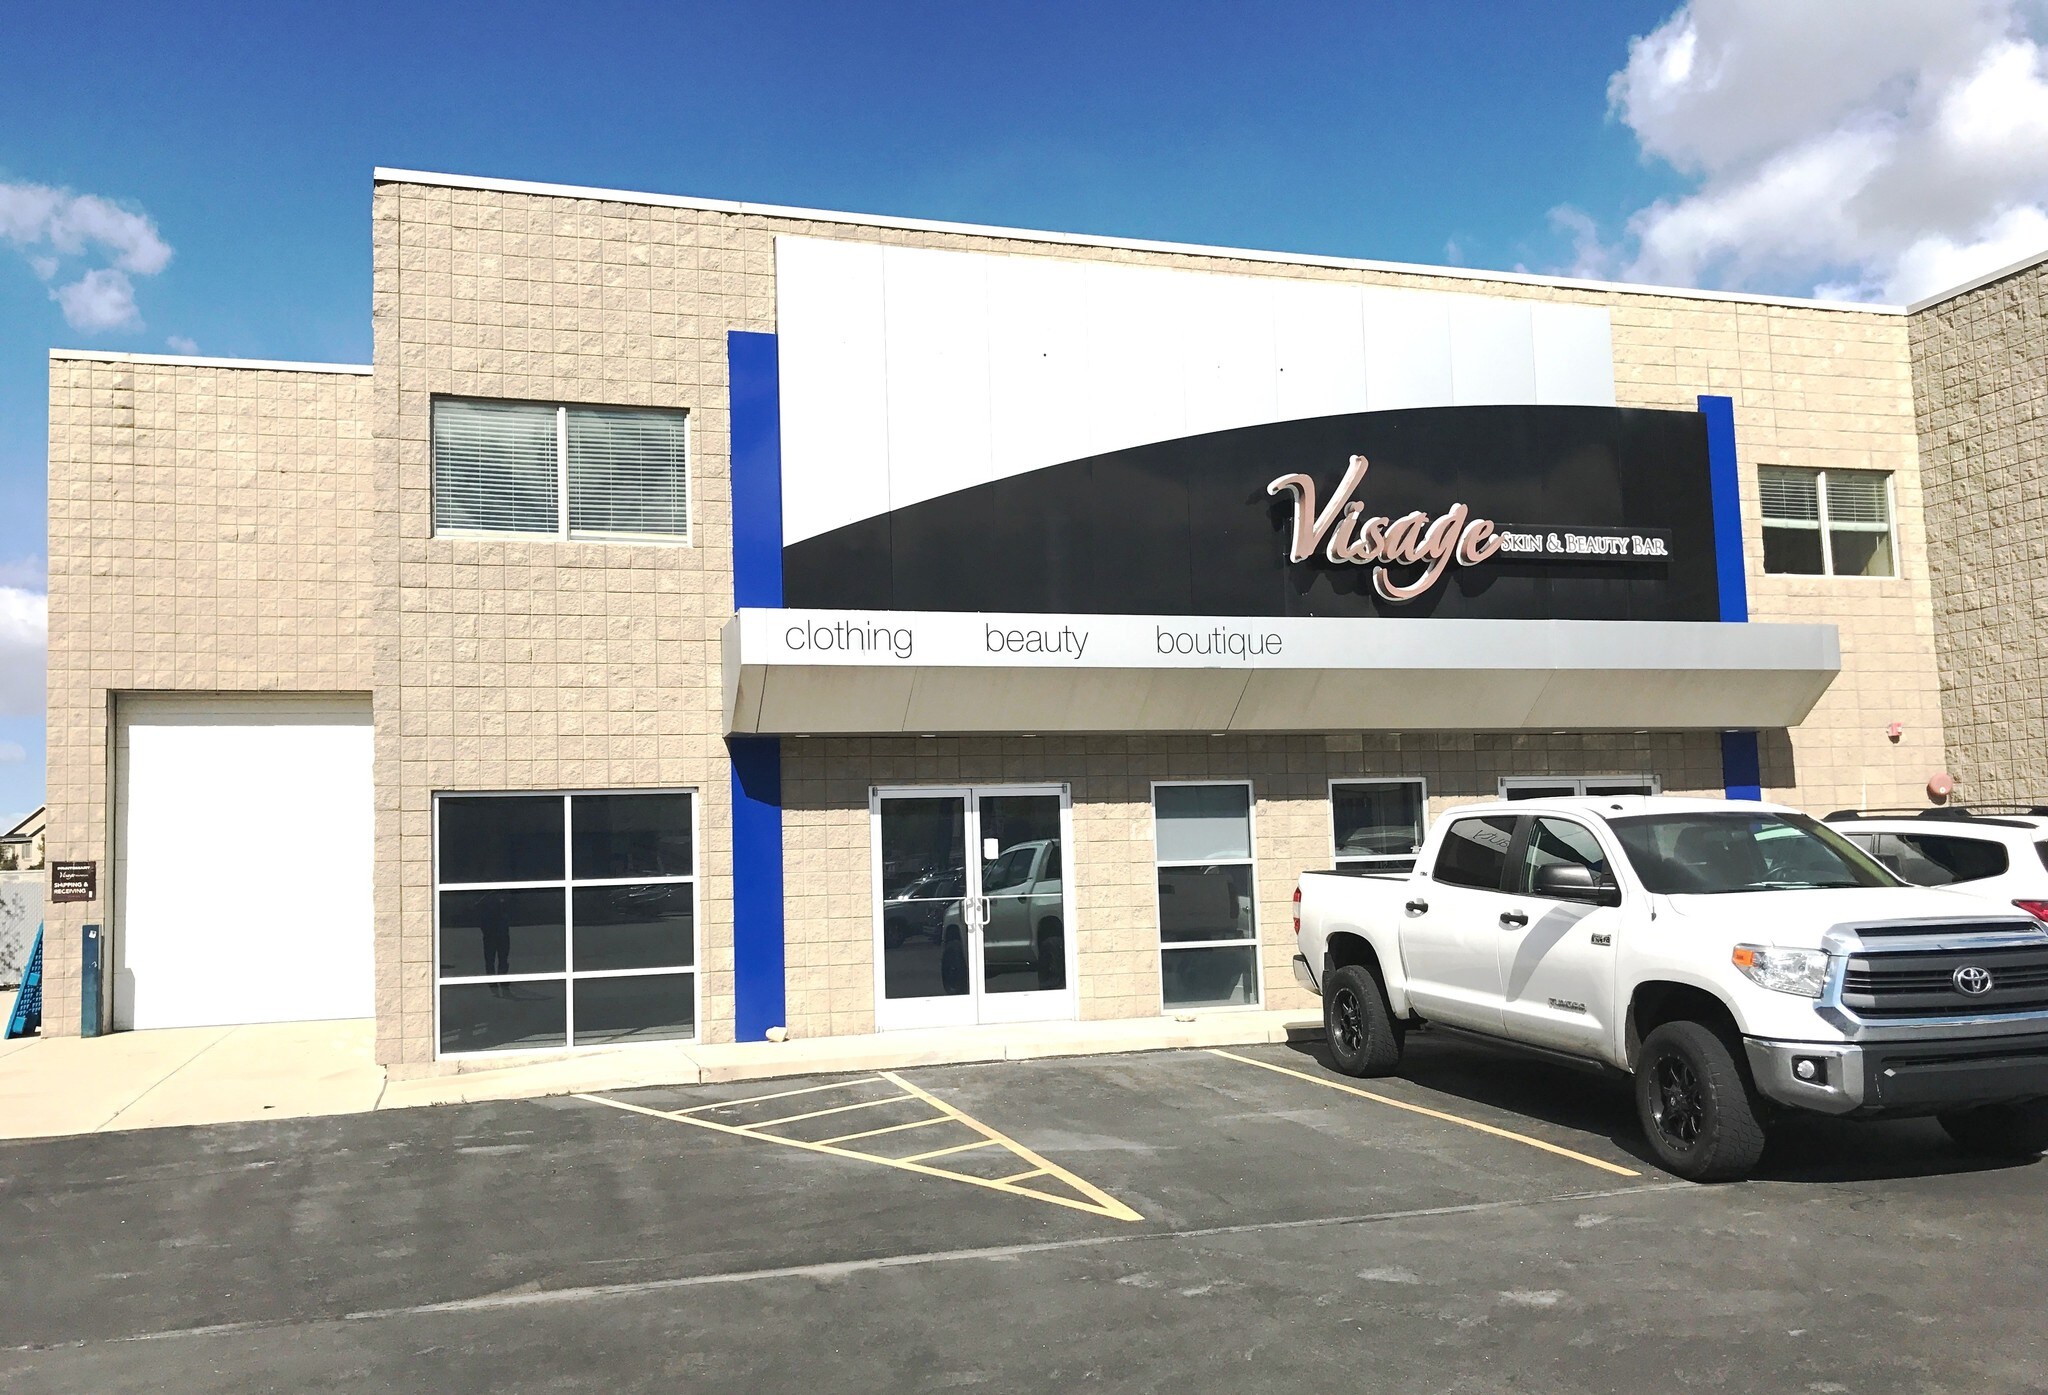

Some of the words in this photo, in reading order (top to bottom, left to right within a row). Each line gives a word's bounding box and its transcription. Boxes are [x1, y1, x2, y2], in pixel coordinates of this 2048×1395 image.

[1267, 454, 1502, 601] Visage
[1501, 531, 1542, 552] SKIN
[1546, 533, 1564, 552] &
[1565, 533, 1629, 555] BEAUTY
[1632, 535, 1668, 556] BAR
[785, 620, 913, 659] clothing
[985, 623, 1089, 660] beauty
[1156, 624, 1283, 661] boutique
